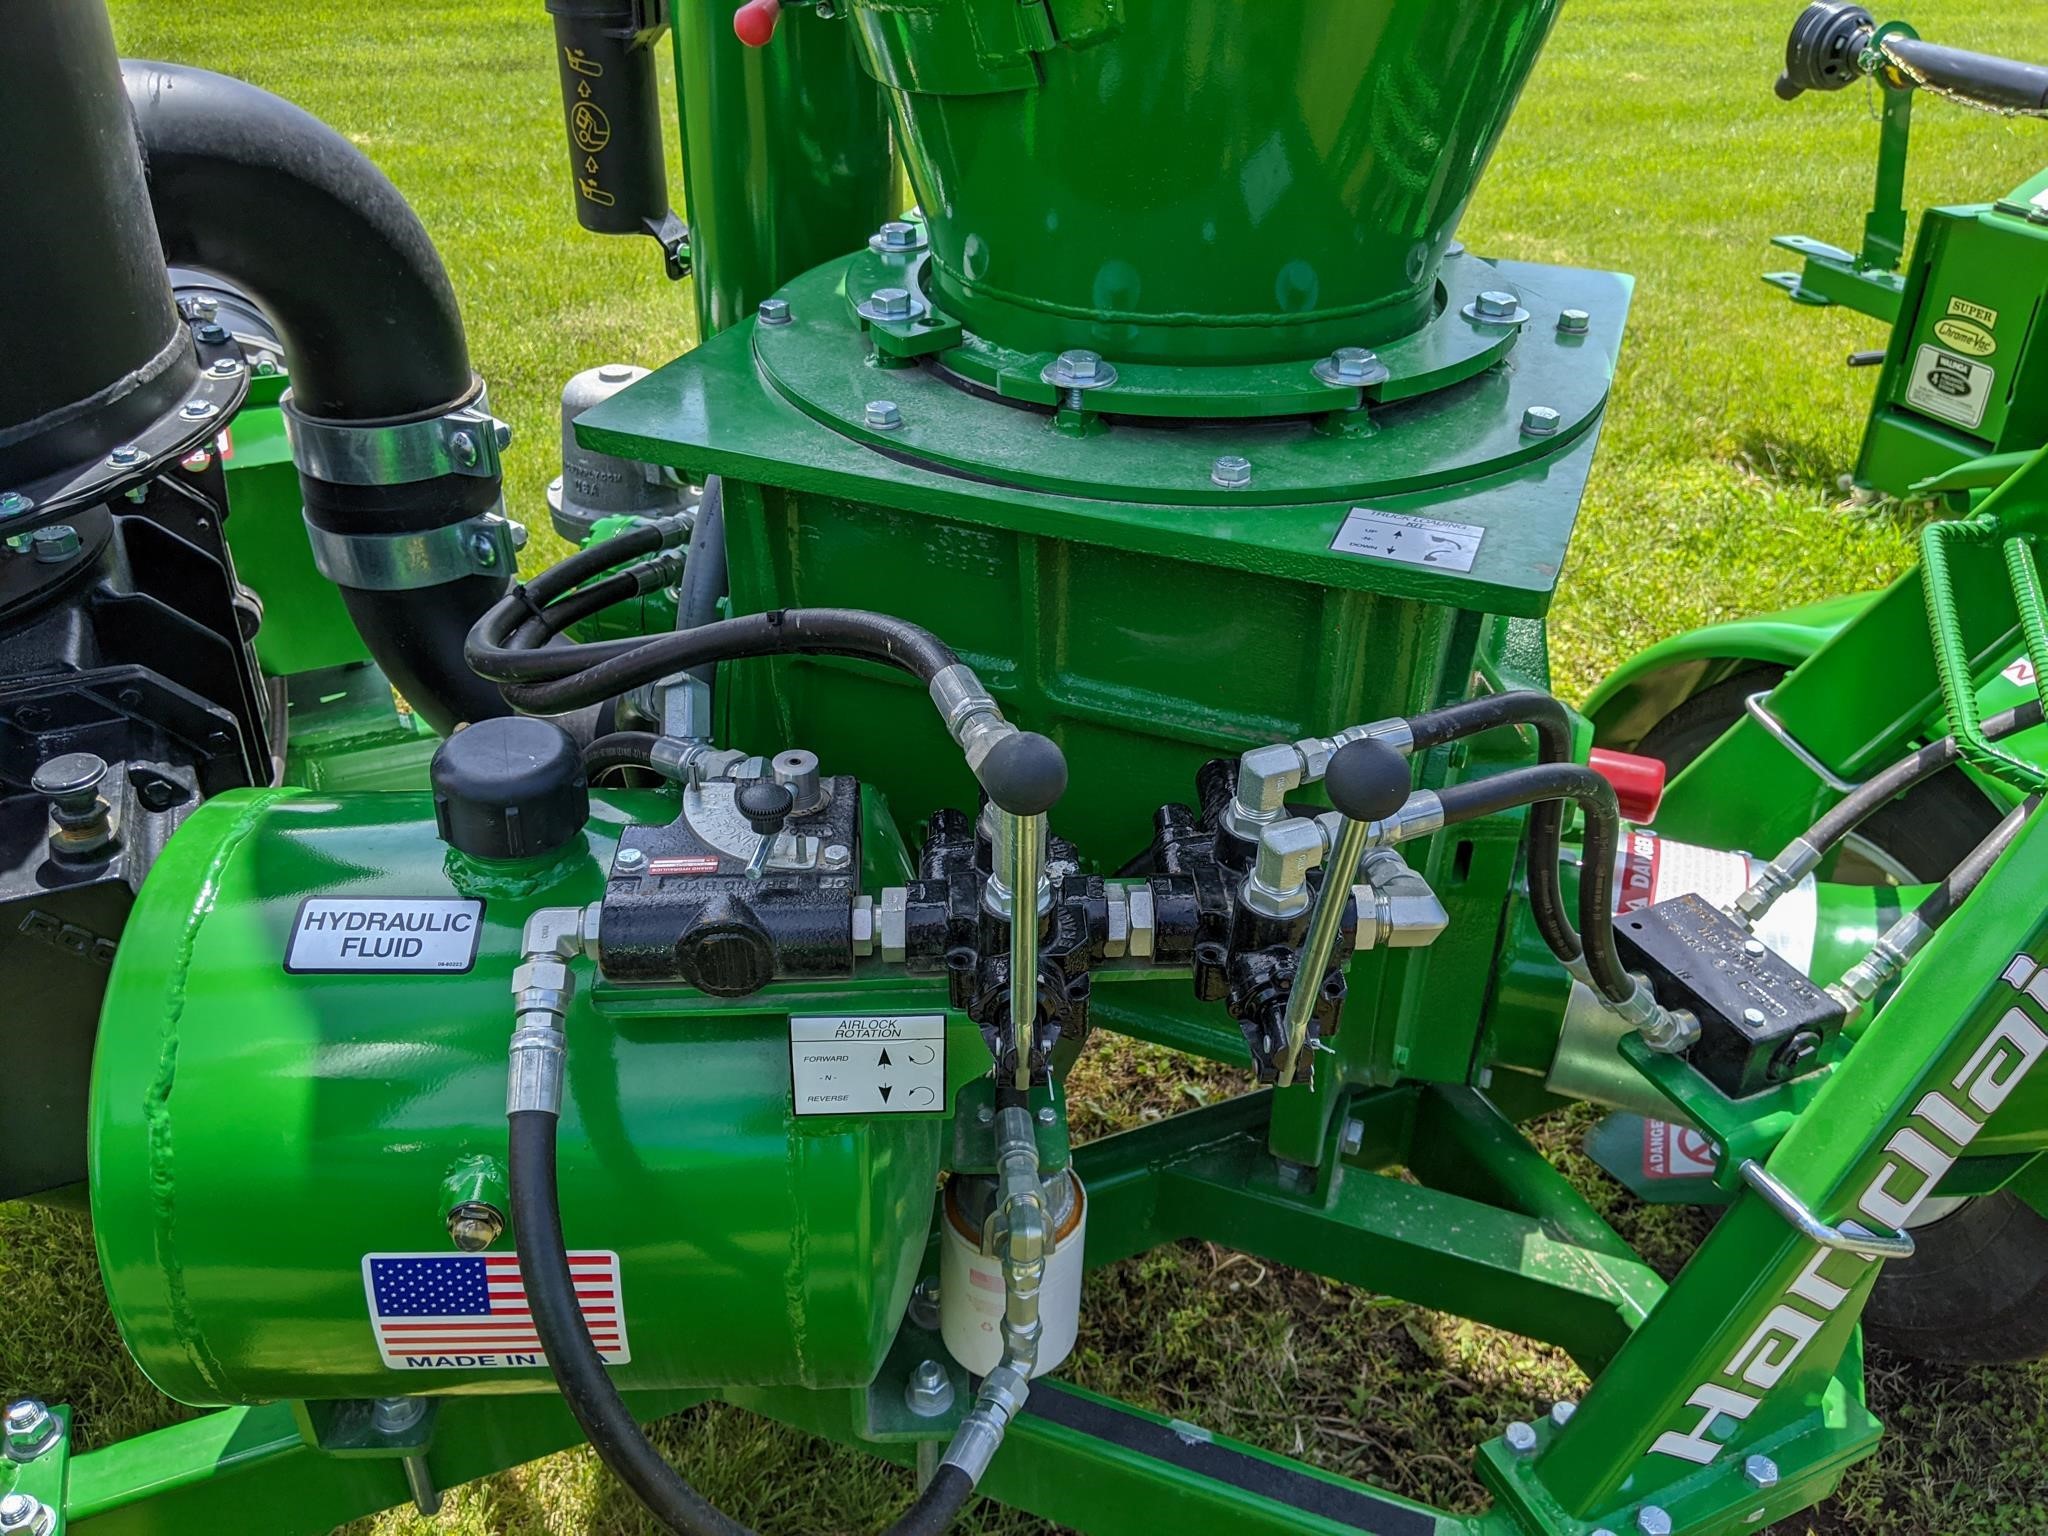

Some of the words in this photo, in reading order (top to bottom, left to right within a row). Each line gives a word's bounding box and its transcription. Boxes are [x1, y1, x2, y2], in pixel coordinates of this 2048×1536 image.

[1952, 301, 1992, 322] SUPER
[1412, 516, 1468, 530] LOADING
[1629, 835, 1655, 890] DANGE
[304, 911, 473, 932] HYDRAULIC
[340, 937, 423, 958] FLUID
[838, 1019, 899, 1030] AIRLOCK
[834, 1029, 902, 1039] ROTATION
[803, 1055, 849, 1063] FORWARD
[807, 1094, 849, 1103] REVERSE
[1649, 1119, 1664, 1163] DANGE
[1645, 951, 2048, 1465] Handlai
[405, 1355, 495, 1367] MADE
[506, 1354, 537, 1365] IN
